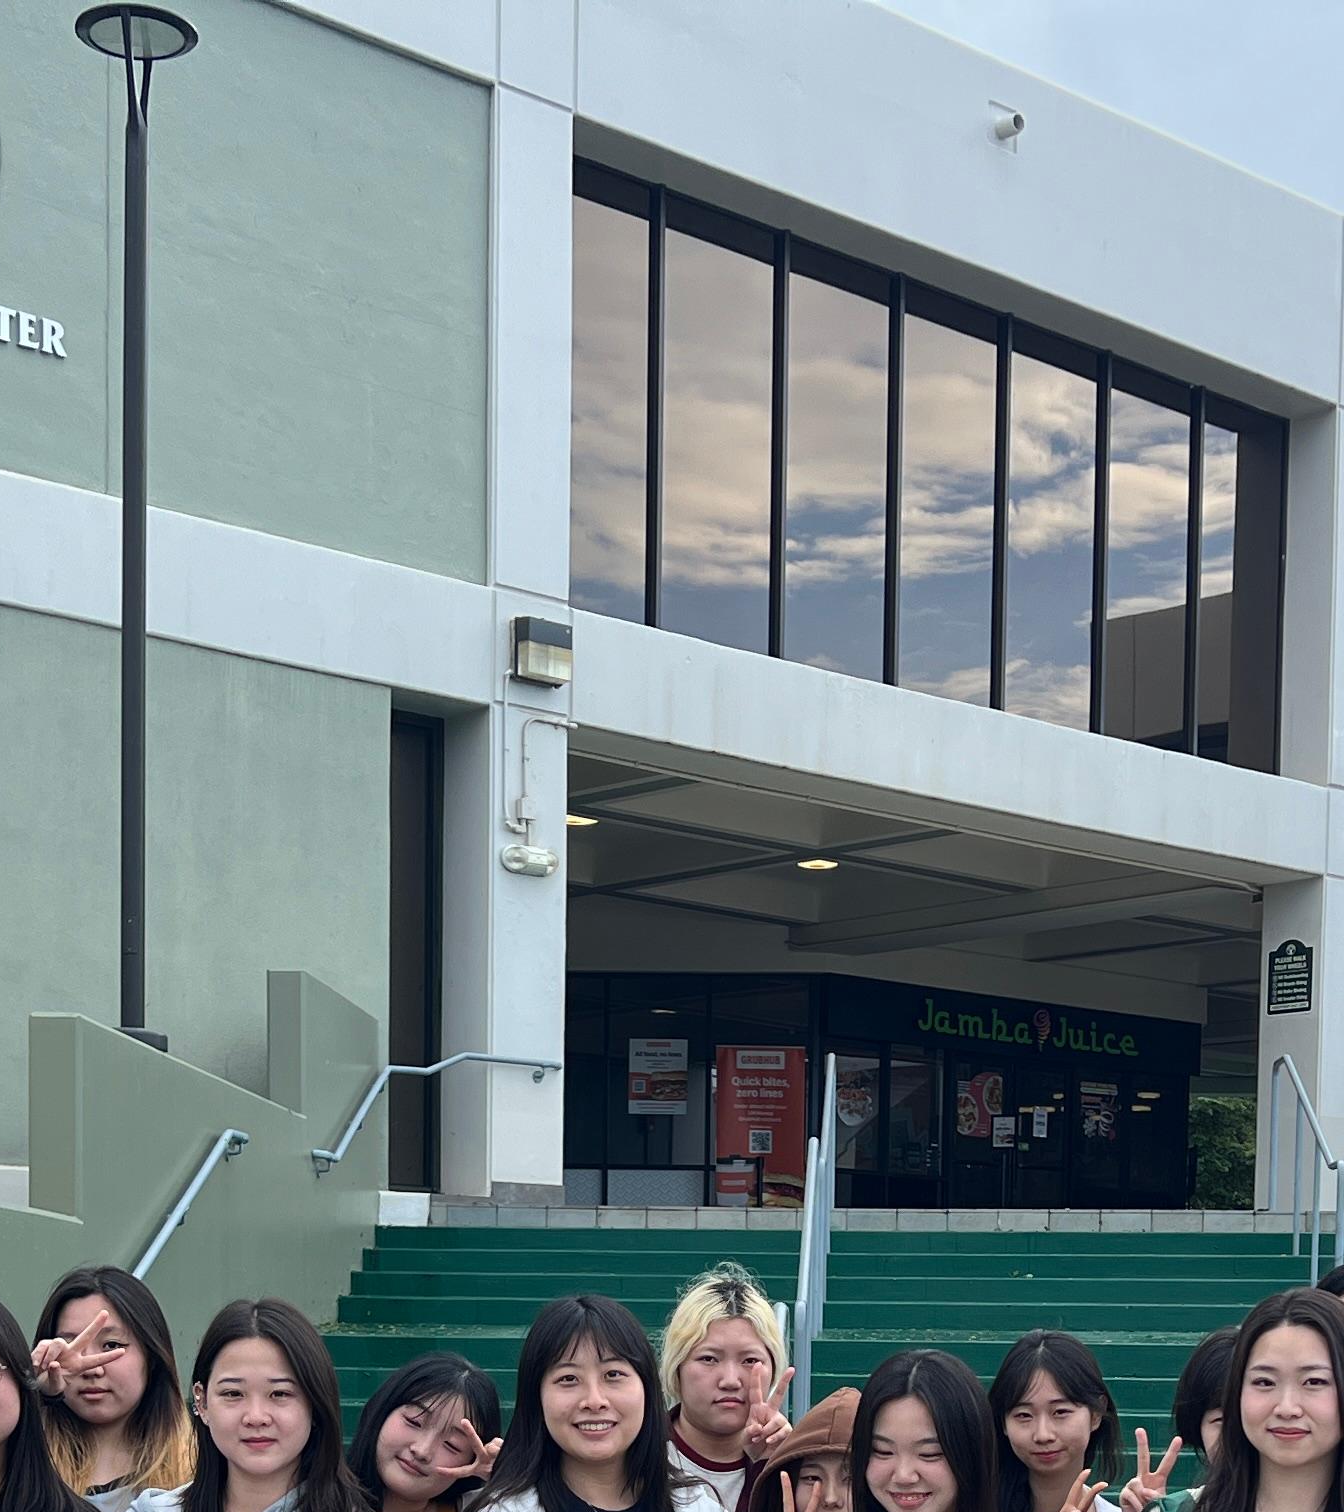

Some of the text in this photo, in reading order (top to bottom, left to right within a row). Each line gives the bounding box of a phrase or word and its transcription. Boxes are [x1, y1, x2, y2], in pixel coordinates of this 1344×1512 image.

[918, 998, 1139, 1057] Jamba Juice
[731, 1076, 790, 1088] Quick bites,
[736, 1088, 784, 1098] zero lines
